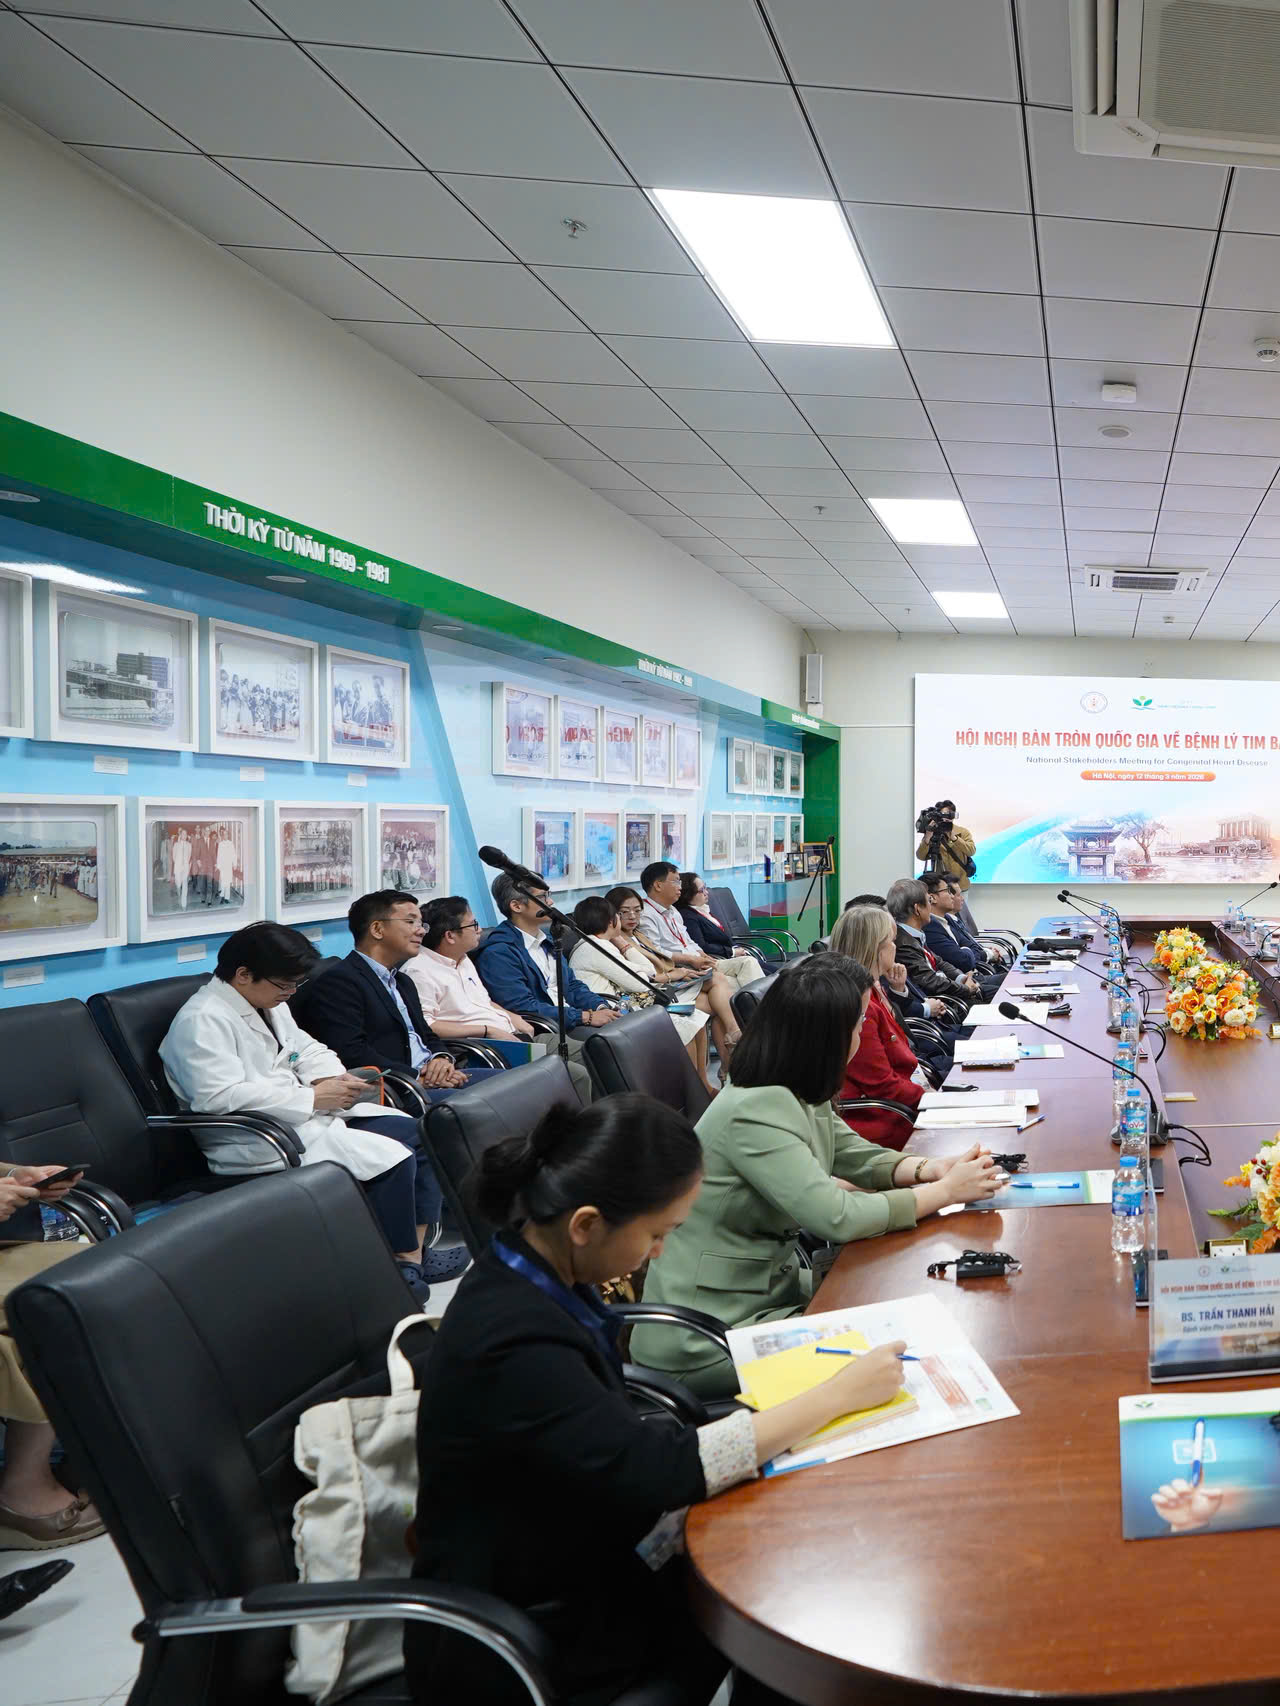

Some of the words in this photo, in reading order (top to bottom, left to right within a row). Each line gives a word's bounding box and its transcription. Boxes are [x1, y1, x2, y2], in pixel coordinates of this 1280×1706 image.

[203, 502, 246, 536] THỜI
[248, 518, 271, 543] KỲ
[271, 527, 295, 552] TỪ
[294, 534, 326, 562] NĂM
[327, 547, 356, 573] 1969
[365, 560, 390, 584] 1981
[956, 728, 979, 748] HỘI
[984, 731, 1017, 749] NGHỊ
[1022, 729, 1050, 747] BÀN
[1055, 730, 1091, 747] TRÒN
[1095, 730, 1132, 749] QUỐC
[1136, 733, 1159, 748] GIA
[1185, 731, 1220, 751] BỆNH
[1224, 732, 1238, 749] LÝ
[1242, 735, 1266, 750] TIM
[1026, 756, 1061, 764] National
[1063, 756, 1117, 765] Stakeholders
[1119, 757, 1152, 767] Meeting
[1154, 757, 1165, 765] for
[1167, 758, 1211, 767] Congenital
[1237, 759, 1268, 767] Disease
[1181, 1311, 1195, 1322] BS.
[1226, 1307, 1257, 1319] THANH
